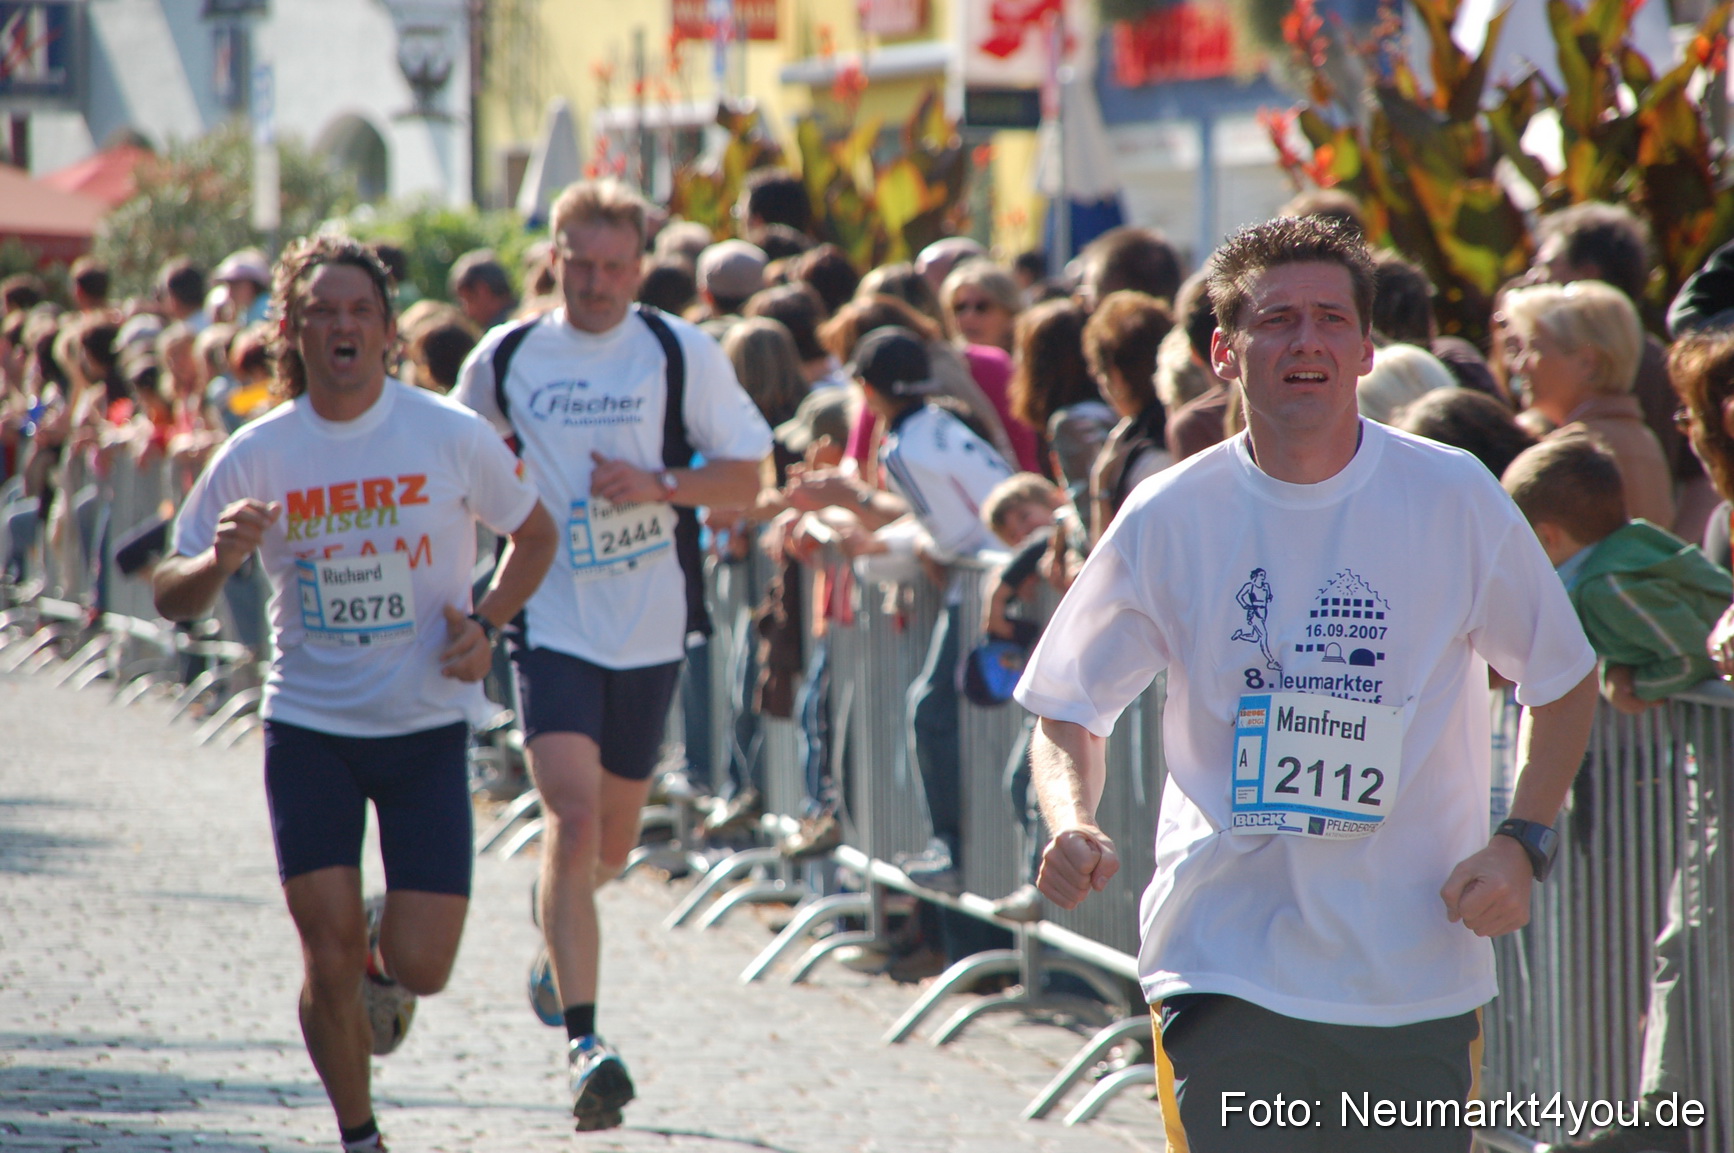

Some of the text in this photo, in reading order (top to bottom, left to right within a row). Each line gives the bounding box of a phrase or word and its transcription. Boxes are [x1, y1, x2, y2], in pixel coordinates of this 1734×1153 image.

[549, 394, 644, 414] Fischer
[286, 474, 429, 521] MERZ
[601, 515, 663, 555] 2444
[323, 563, 383, 585] Richard
[330, 592, 406, 624] 2678
[1305, 624, 1388, 640] 16.09.2007
[1276, 705, 1367, 742] Manfred
[1239, 748, 1248, 768] A
[1274, 756, 1385, 806] 2112
[1234, 813, 1287, 828] BOCK
